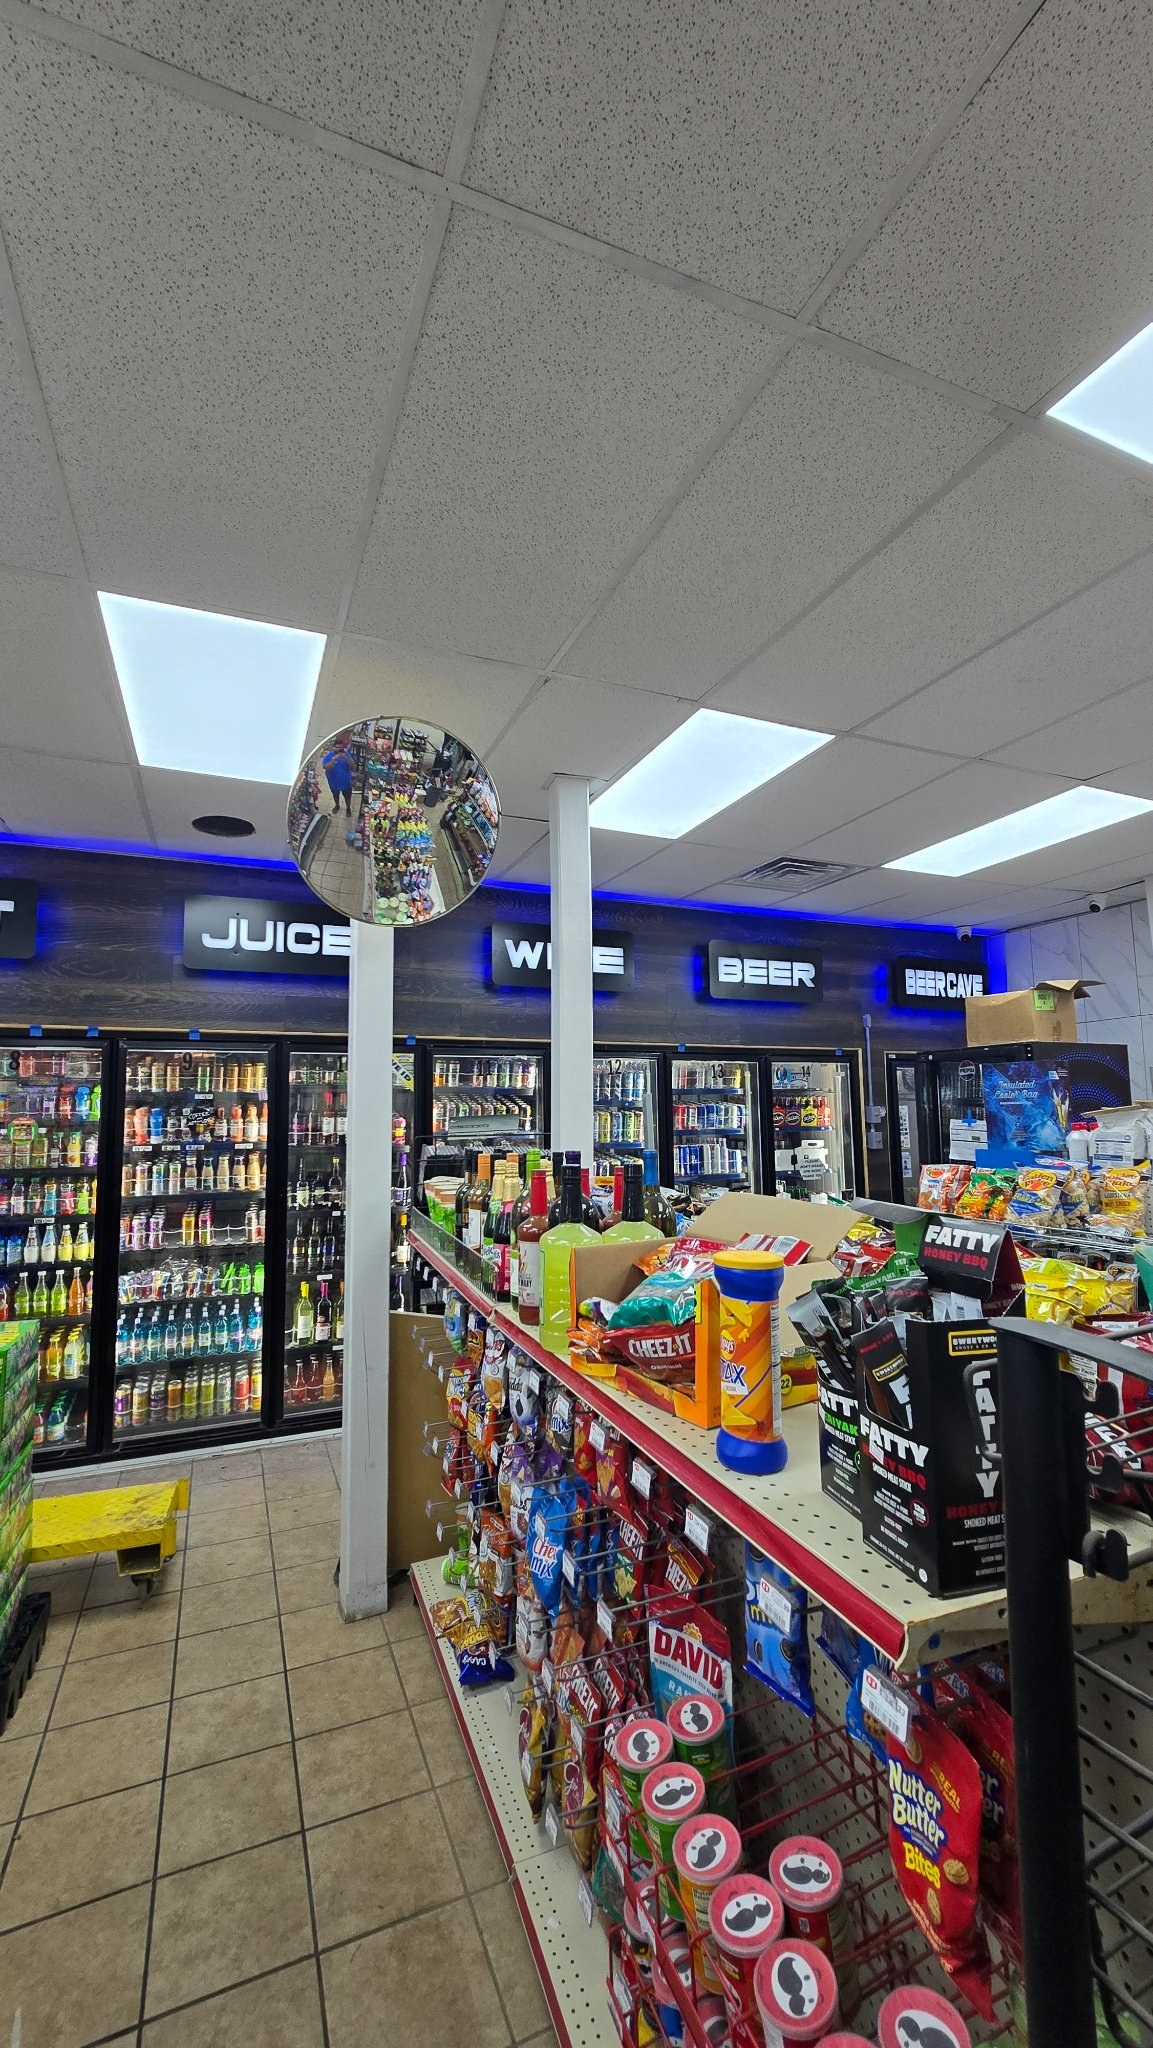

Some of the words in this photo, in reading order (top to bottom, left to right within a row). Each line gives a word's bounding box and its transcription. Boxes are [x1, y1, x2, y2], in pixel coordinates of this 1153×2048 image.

[201, 918, 350, 956] JUICE
[504, 939, 625, 975] WIE
[718, 956, 816, 988] BEER
[905, 968, 946, 998] BEER
[946, 973, 984, 998] CAVE
[9, 1050, 22, 1071] 8
[182, 1051, 194, 1071] 9
[608, 1059, 622, 1076] 12
[711, 1063, 725, 1080] 13
[994, 1089, 1020, 1100] Cooler
[1022, 1089, 1039, 1100] Bag
[998, 1079, 1036, 1090] Insulated
[924, 1224, 1000, 1253] FATTY
[924, 1247, 963, 1264] HONEY
[962, 1252, 989, 1271] BBQ
[824, 1412, 859, 1437] ERIYAK
[860, 1413, 930, 1468] FATTY
[897, 1464, 928, 1491] BBQ
[899, 1478, 913, 1493] STICK
[963, 1517, 987, 1529] SMOKED
[986, 1514, 1001, 1526] MEAT
[530, 1556, 558, 1579] mix
[653, 1626, 723, 1690] DAVID
[888, 1757, 942, 1819] Nutter
[938, 1770, 962, 1809] REAL
[892, 1792, 945, 1849] Butter
[902, 1841, 942, 1889] Bites
